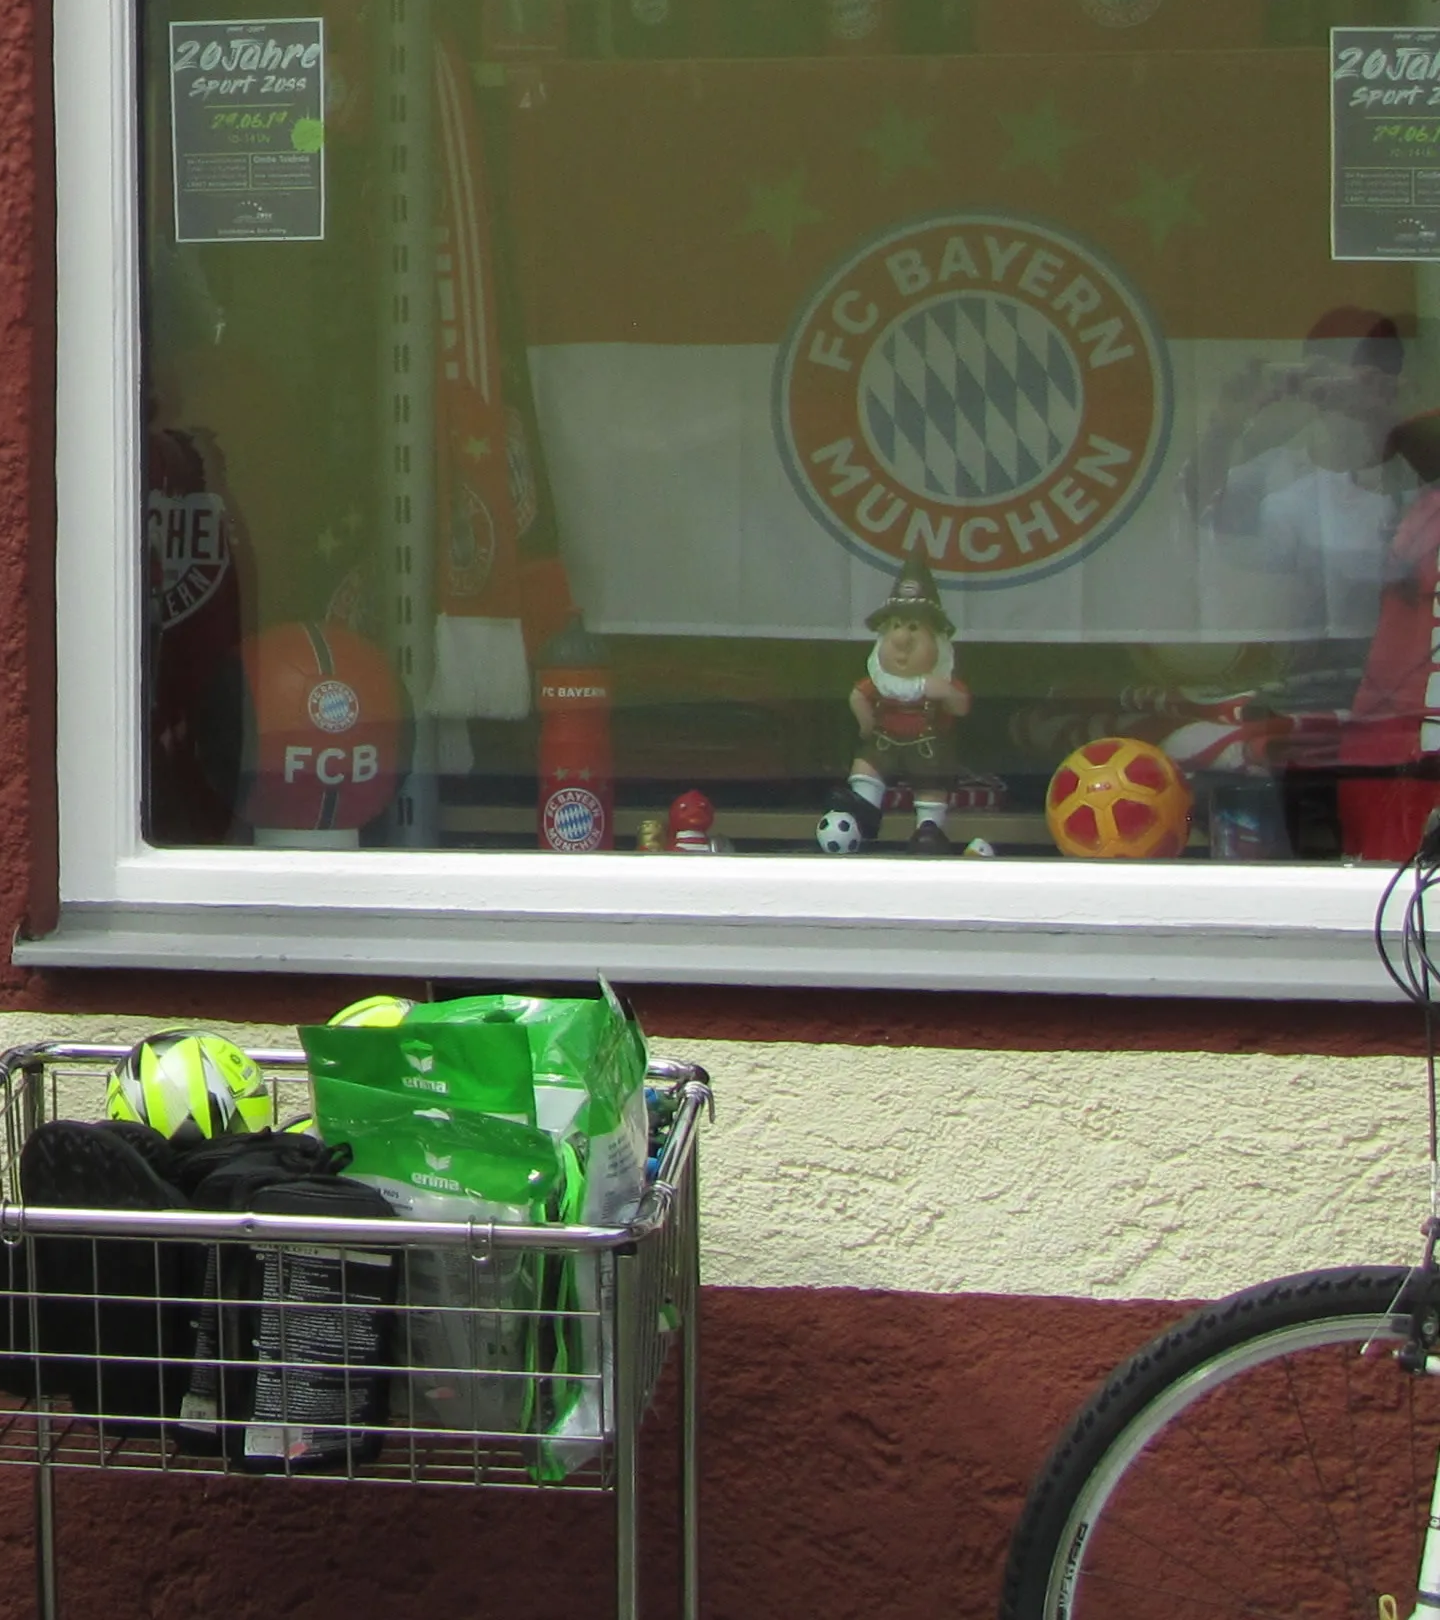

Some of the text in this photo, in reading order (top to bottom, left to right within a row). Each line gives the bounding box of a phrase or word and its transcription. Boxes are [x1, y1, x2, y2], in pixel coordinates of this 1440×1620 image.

[189, 75, 257, 100] Sport
[1349, 84, 1425, 109] Sport
[807, 234, 1136, 373] FC BAYERN
[810, 433, 1132, 563] MÜNCHEN
[284, 744, 378, 785] FCB
[401, 1076, 448, 1094] erima
[411, 1171, 461, 1193] erima
